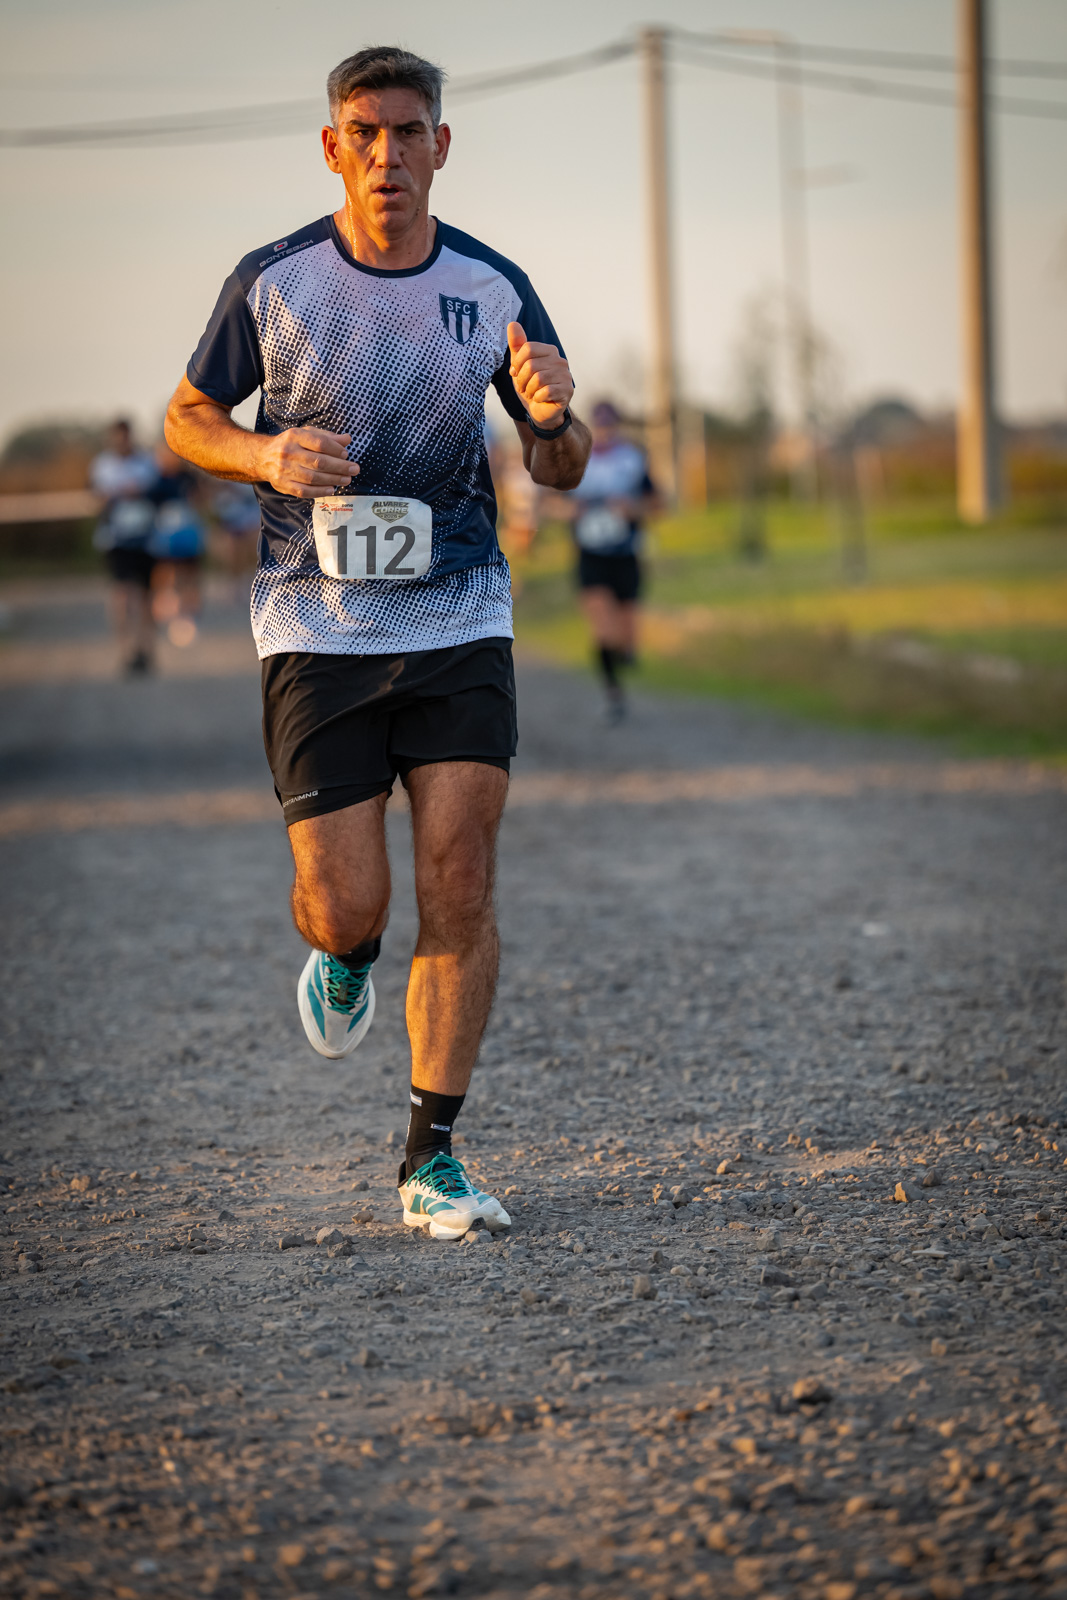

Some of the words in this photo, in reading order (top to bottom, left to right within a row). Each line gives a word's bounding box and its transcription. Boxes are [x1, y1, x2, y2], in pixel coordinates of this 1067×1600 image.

[446, 300, 471, 315] SFC
[374, 506, 409, 514] CORRE
[327, 525, 416, 575] 112
